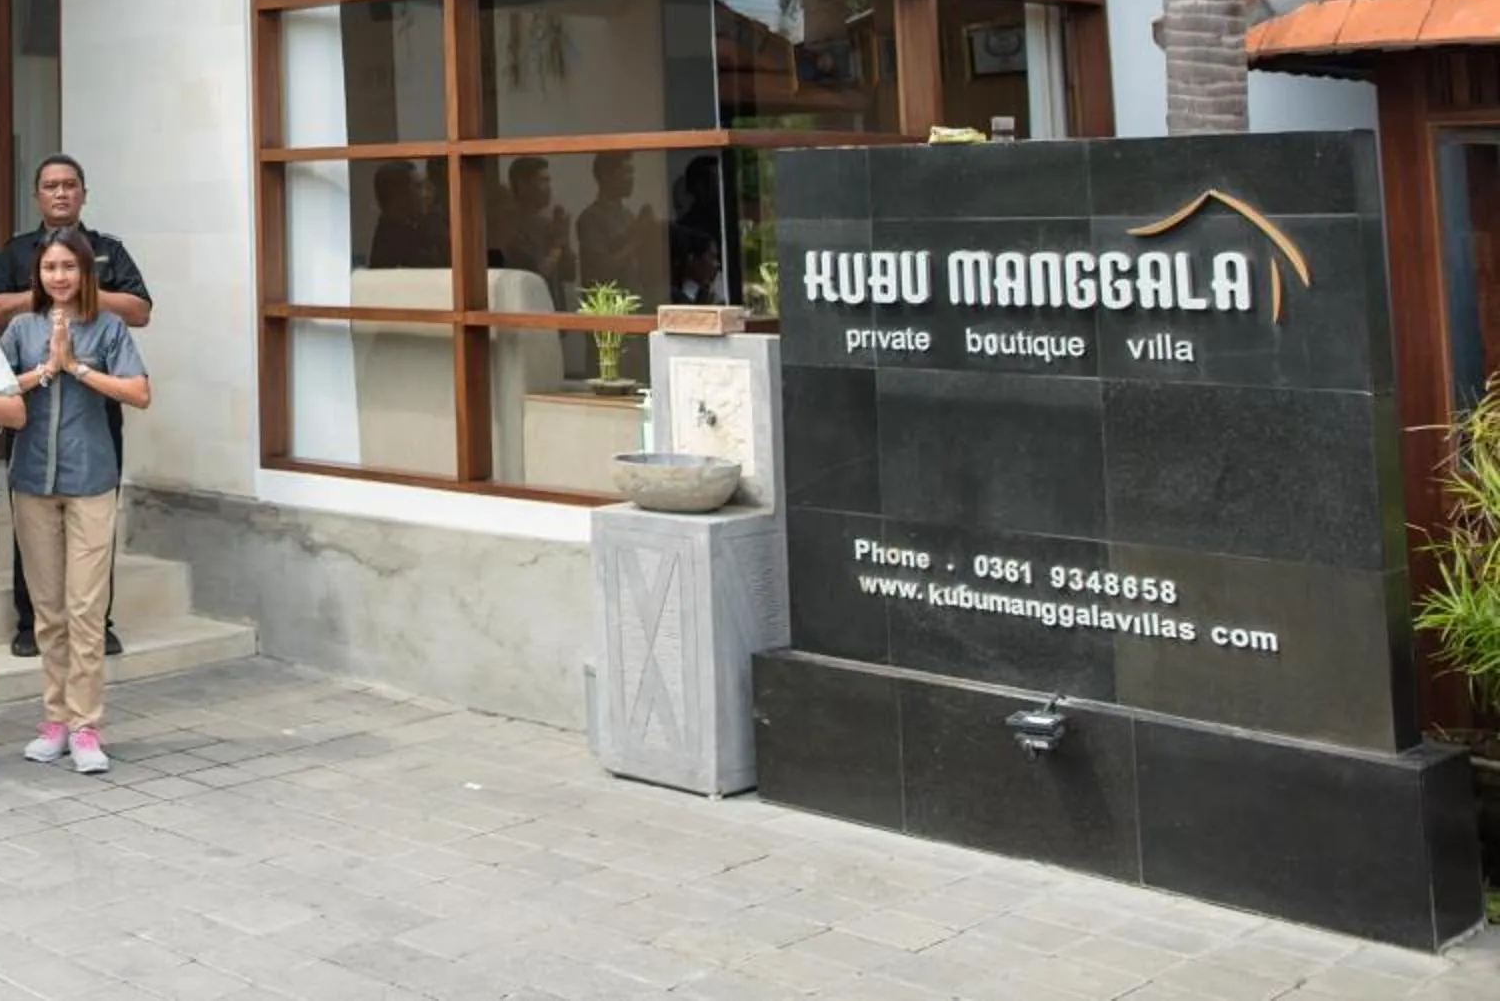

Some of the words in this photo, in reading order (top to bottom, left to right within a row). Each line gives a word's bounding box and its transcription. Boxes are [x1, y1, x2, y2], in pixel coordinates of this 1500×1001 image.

[803, 249, 931, 305] KUBU
[947, 249, 1252, 311] MANGGALA
[845, 326, 932, 354] private
[965, 327, 1085, 363] boutique
[1126, 332, 1195, 362] villa
[854, 538, 931, 570] Phone
[973, 554, 1033, 585] 0361
[1049, 565, 1178, 604] 9348658
